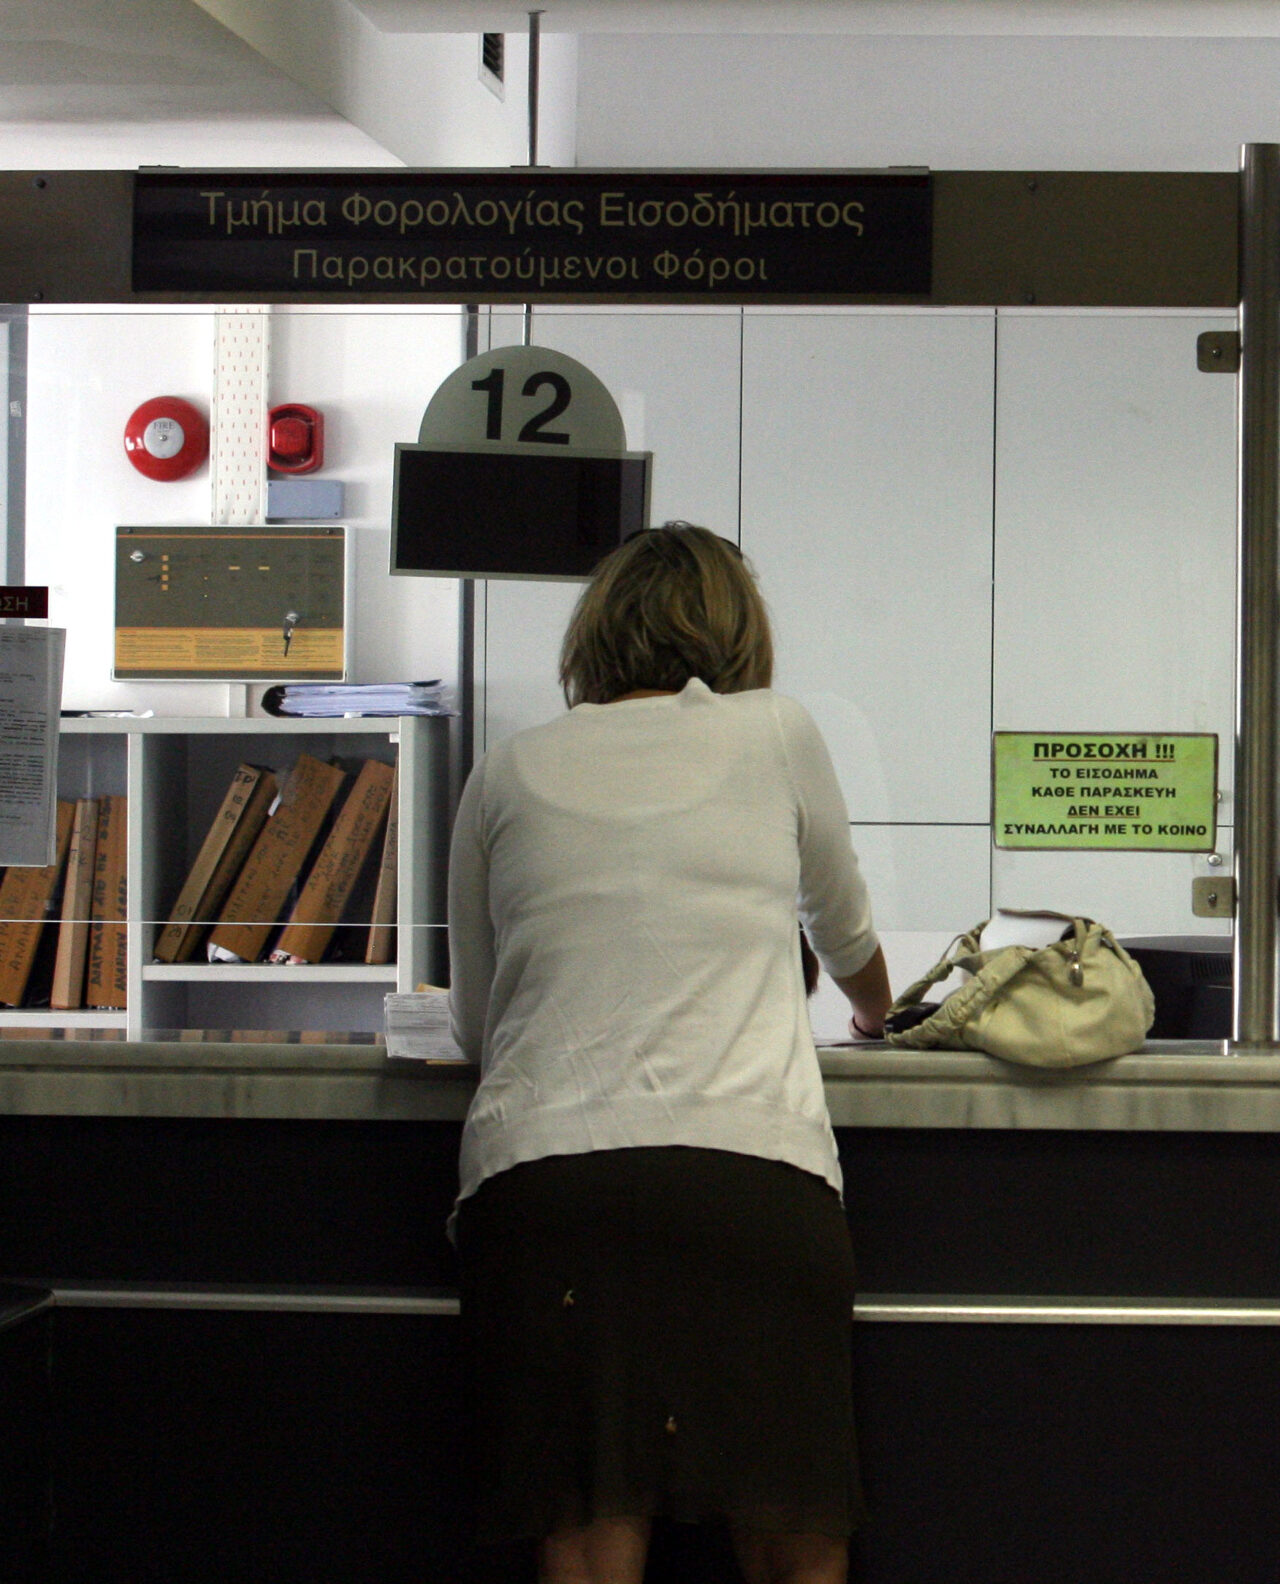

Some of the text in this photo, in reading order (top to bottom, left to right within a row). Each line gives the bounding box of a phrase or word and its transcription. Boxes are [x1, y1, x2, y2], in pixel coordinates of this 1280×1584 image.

[200, 190, 865, 236] Τμήμα Φορολογίας Εισοδήματος
[293, 247, 768, 288] Παρακρατούμενοι Φόροι
[471, 368, 572, 445] 12
[153, 421, 177, 430] FIRE
[0, 596, 29, 611] ΣΗ
[1033, 743, 1175, 759] ΠΡΟΣΟΧΗ !!!
[1050, 768, 1159, 780] ΤΟ ΕΙΣΟΔΗΜΑ
[1032, 786, 1176, 798] ΚΑΘΕ ΠΑΡΑΣΚΕΥΗ
[1067, 805, 1140, 816] ΔΕΝ ΕΧΕΙ
[1004, 824, 1207, 836] ΣΥΝΑΛΛΑΓΗ ΜΕ ΤΟ ΚΟΙΝΟ
